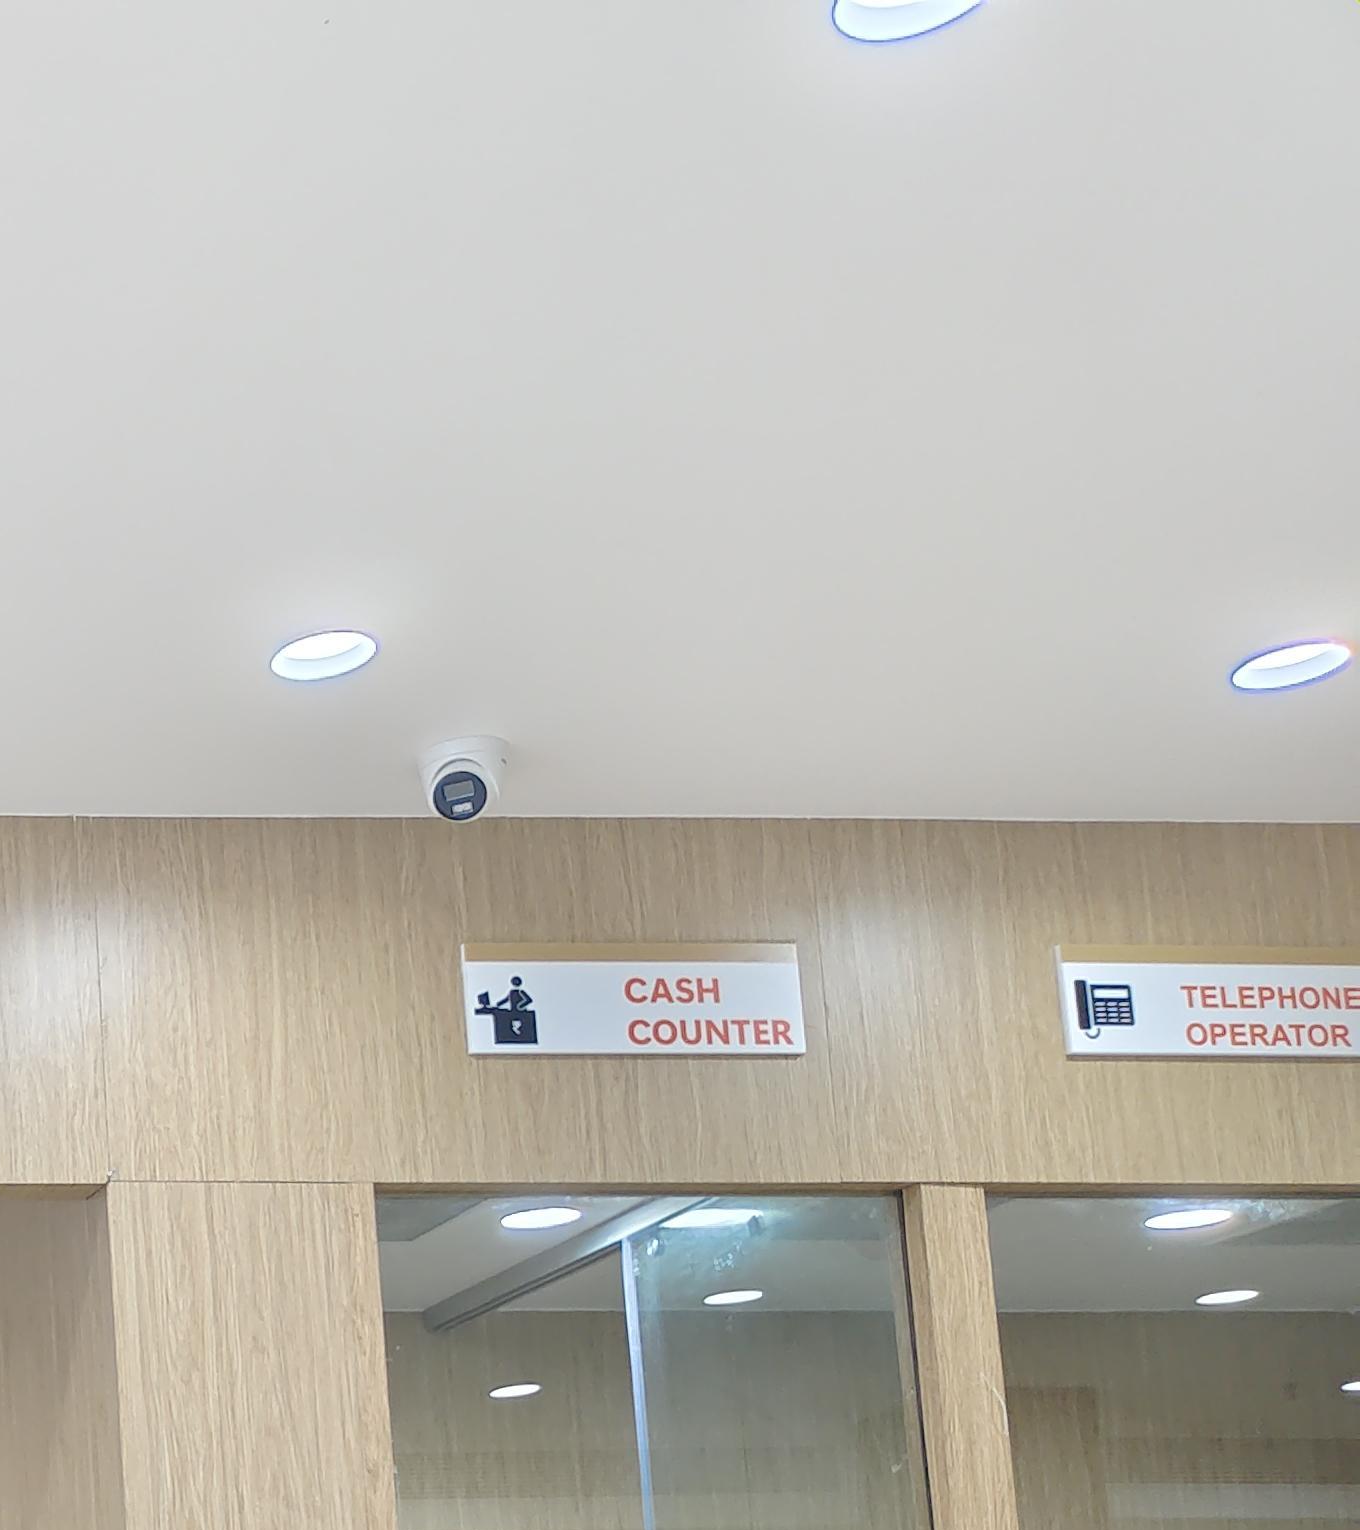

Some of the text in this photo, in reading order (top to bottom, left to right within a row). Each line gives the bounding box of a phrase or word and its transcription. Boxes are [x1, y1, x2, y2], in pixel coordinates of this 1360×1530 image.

[623, 977, 721, 1004] CASH
[1180, 985, 1360, 1010] TELEPHONE
[627, 1018, 795, 1046] COUNTER
[1185, 1022, 1352, 1048] OPERATOR
